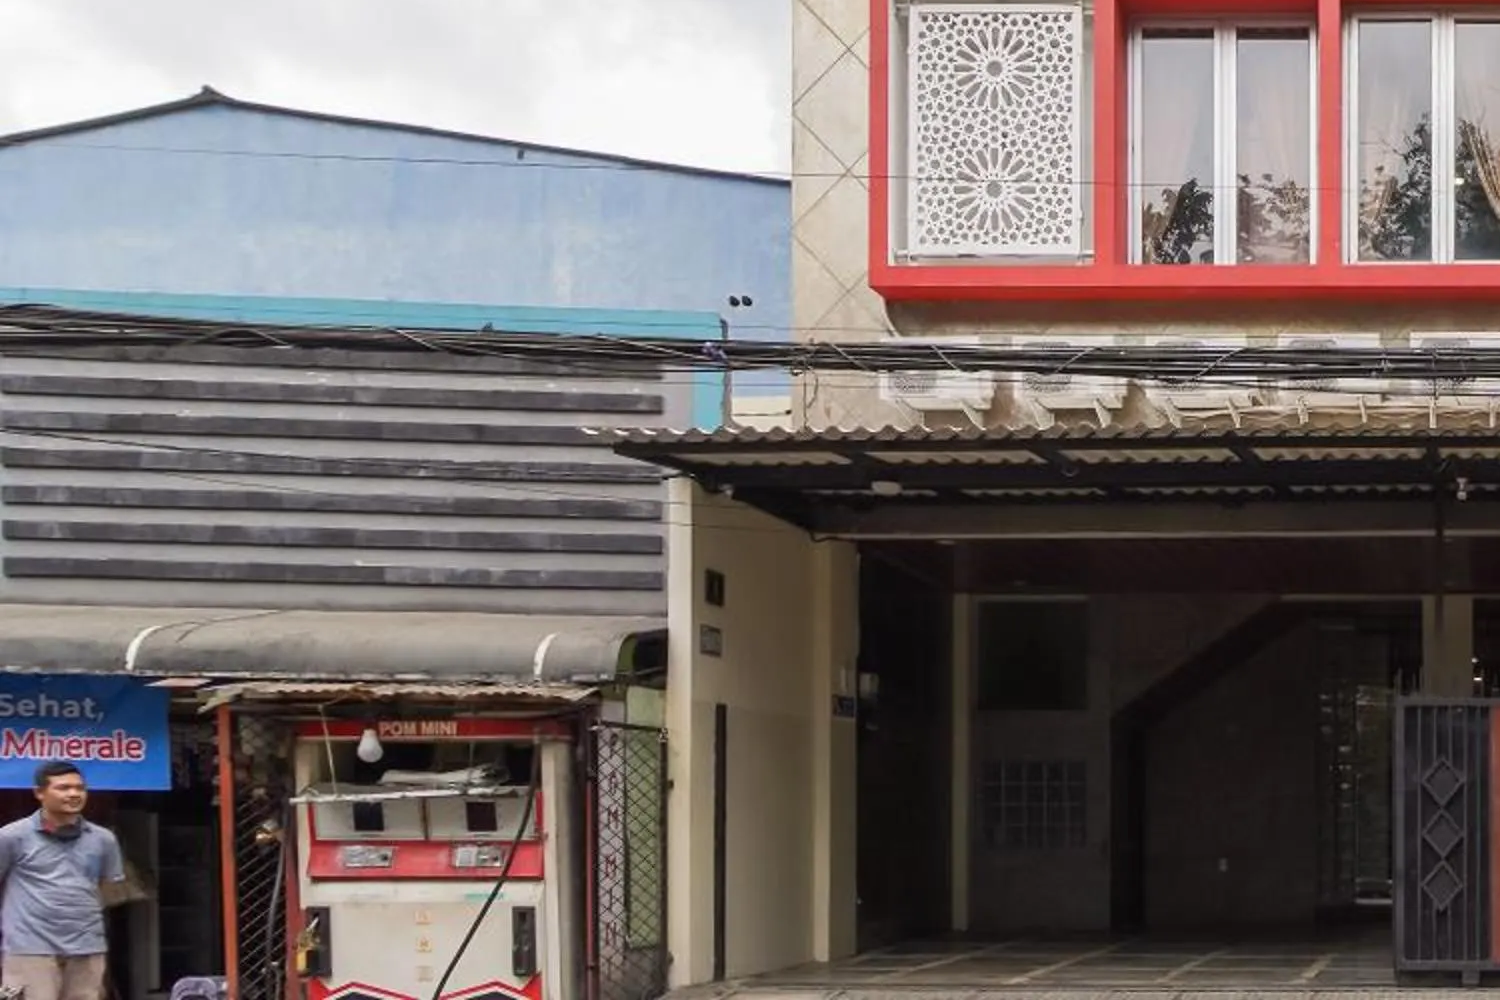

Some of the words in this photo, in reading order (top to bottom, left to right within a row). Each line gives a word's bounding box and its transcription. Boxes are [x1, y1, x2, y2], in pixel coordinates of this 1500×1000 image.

[0, 693, 104, 722] Sehat,
[379, 721, 417, 736] POM
[420, 720, 458, 736] MINI
[2, 728, 146, 761] Minerale
